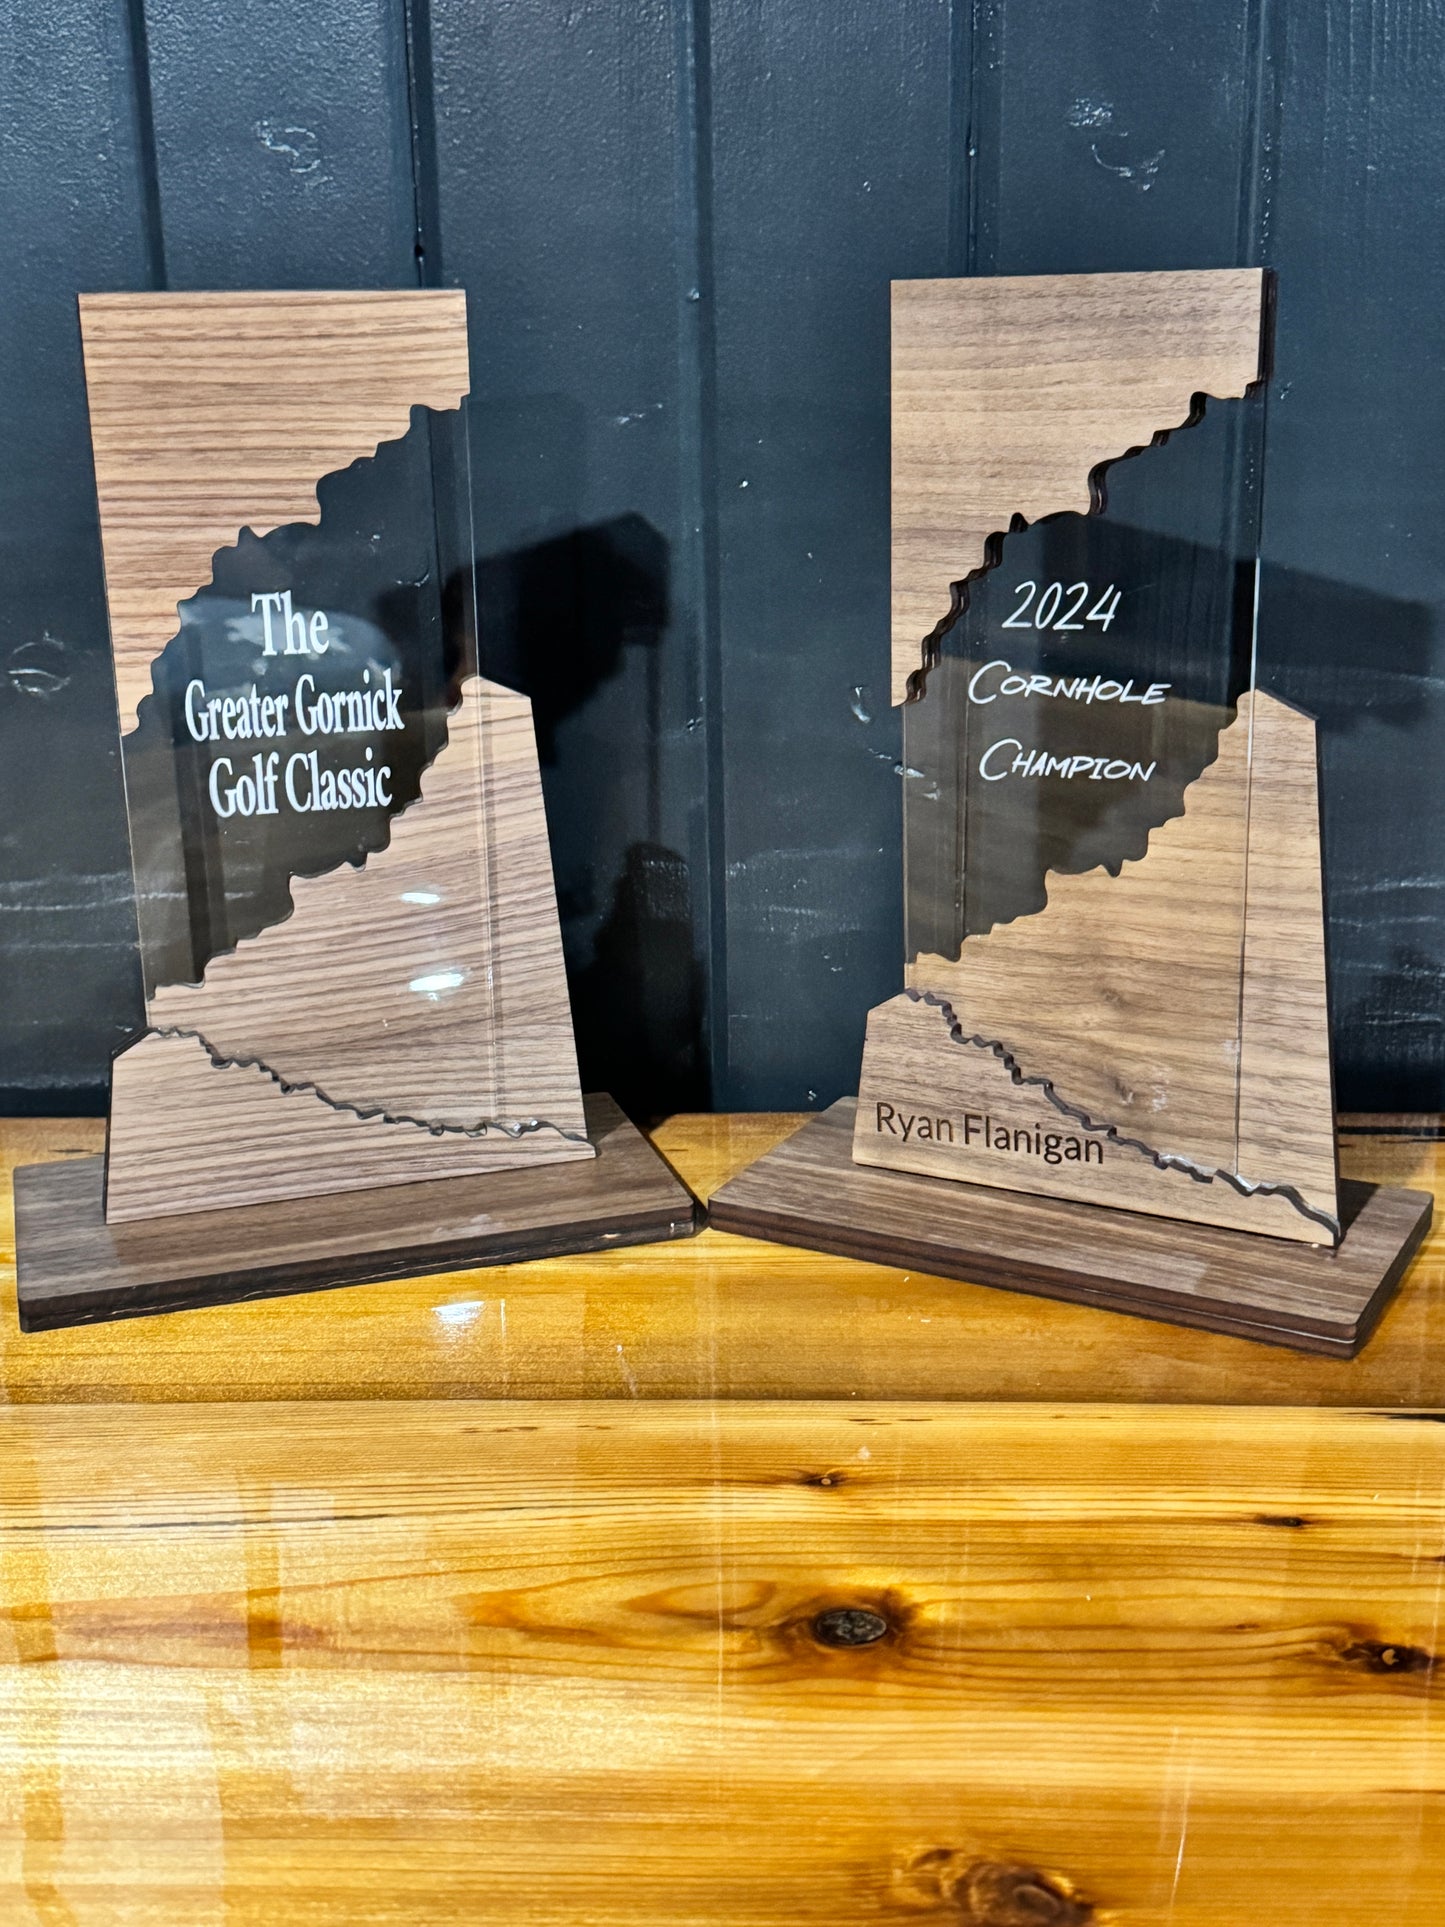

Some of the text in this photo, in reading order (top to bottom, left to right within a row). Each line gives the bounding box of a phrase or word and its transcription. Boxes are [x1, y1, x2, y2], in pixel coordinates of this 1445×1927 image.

[251, 590, 330, 656] The
[1001, 581, 1122, 632] 2024
[184, 668, 405, 742] Greater Gornick
[208, 747, 393, 818] Golf Classic
[875, 1101, 1104, 1165] Ryan Flanigan
